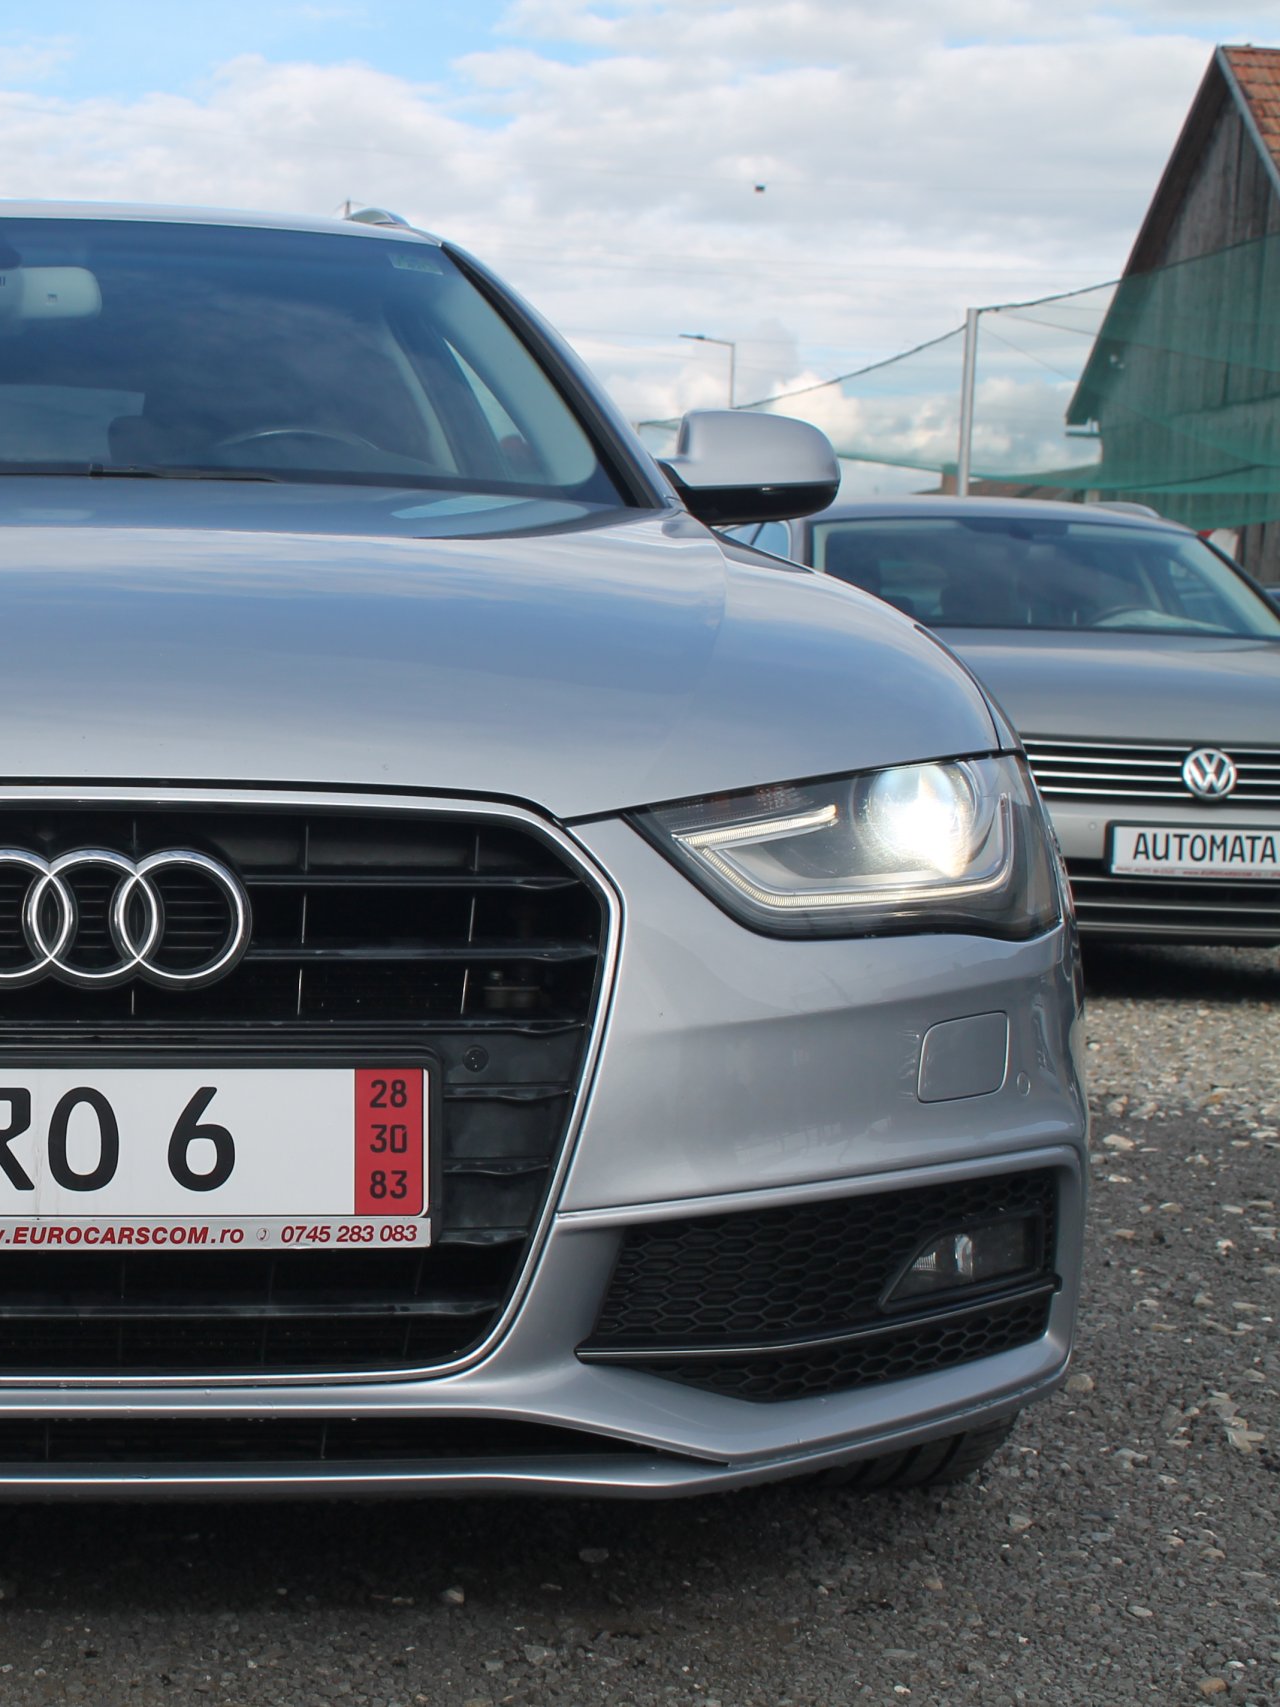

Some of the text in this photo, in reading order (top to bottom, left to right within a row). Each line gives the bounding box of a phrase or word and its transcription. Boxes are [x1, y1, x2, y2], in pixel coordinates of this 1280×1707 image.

[1132, 832, 1277, 864] AUTOMATA
[369, 1079, 408, 1109] 28
[167, 1086, 236, 1192] 6
[369, 1124, 408, 1154] 30
[369, 1170, 408, 1199] 83
[280, 1224, 332, 1244] 0745
[335, 1224, 375, 1243] 283
[379, 1224, 418, 1243] 083
